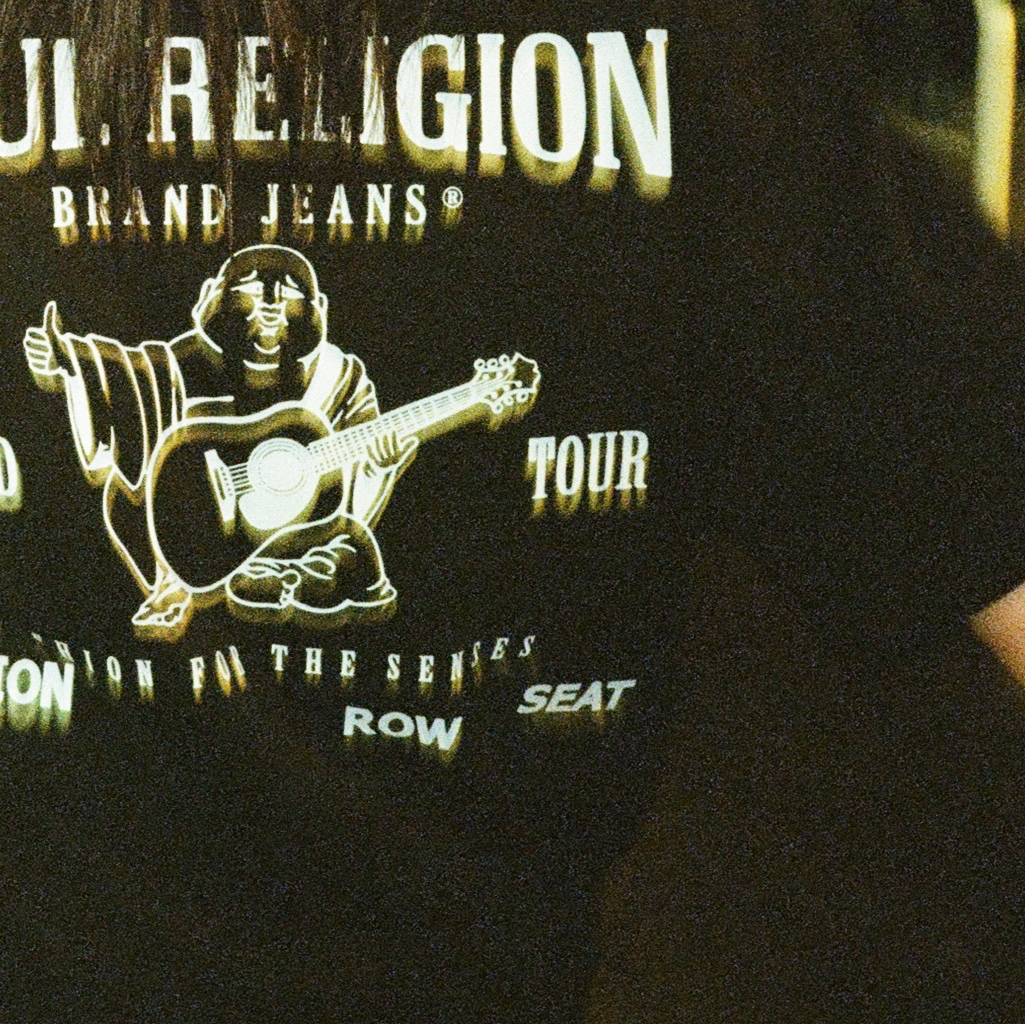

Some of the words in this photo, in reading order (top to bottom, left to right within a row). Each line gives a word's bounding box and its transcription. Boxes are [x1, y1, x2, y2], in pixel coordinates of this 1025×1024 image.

[52, 184, 225, 228] BRAND
[528, 430, 649, 499] TOUR
[271, 644, 356, 677] THE
[387, 635, 536, 683] SENSES
[517, 679, 637, 714] SEAT
[343, 706, 462, 751] ROW
